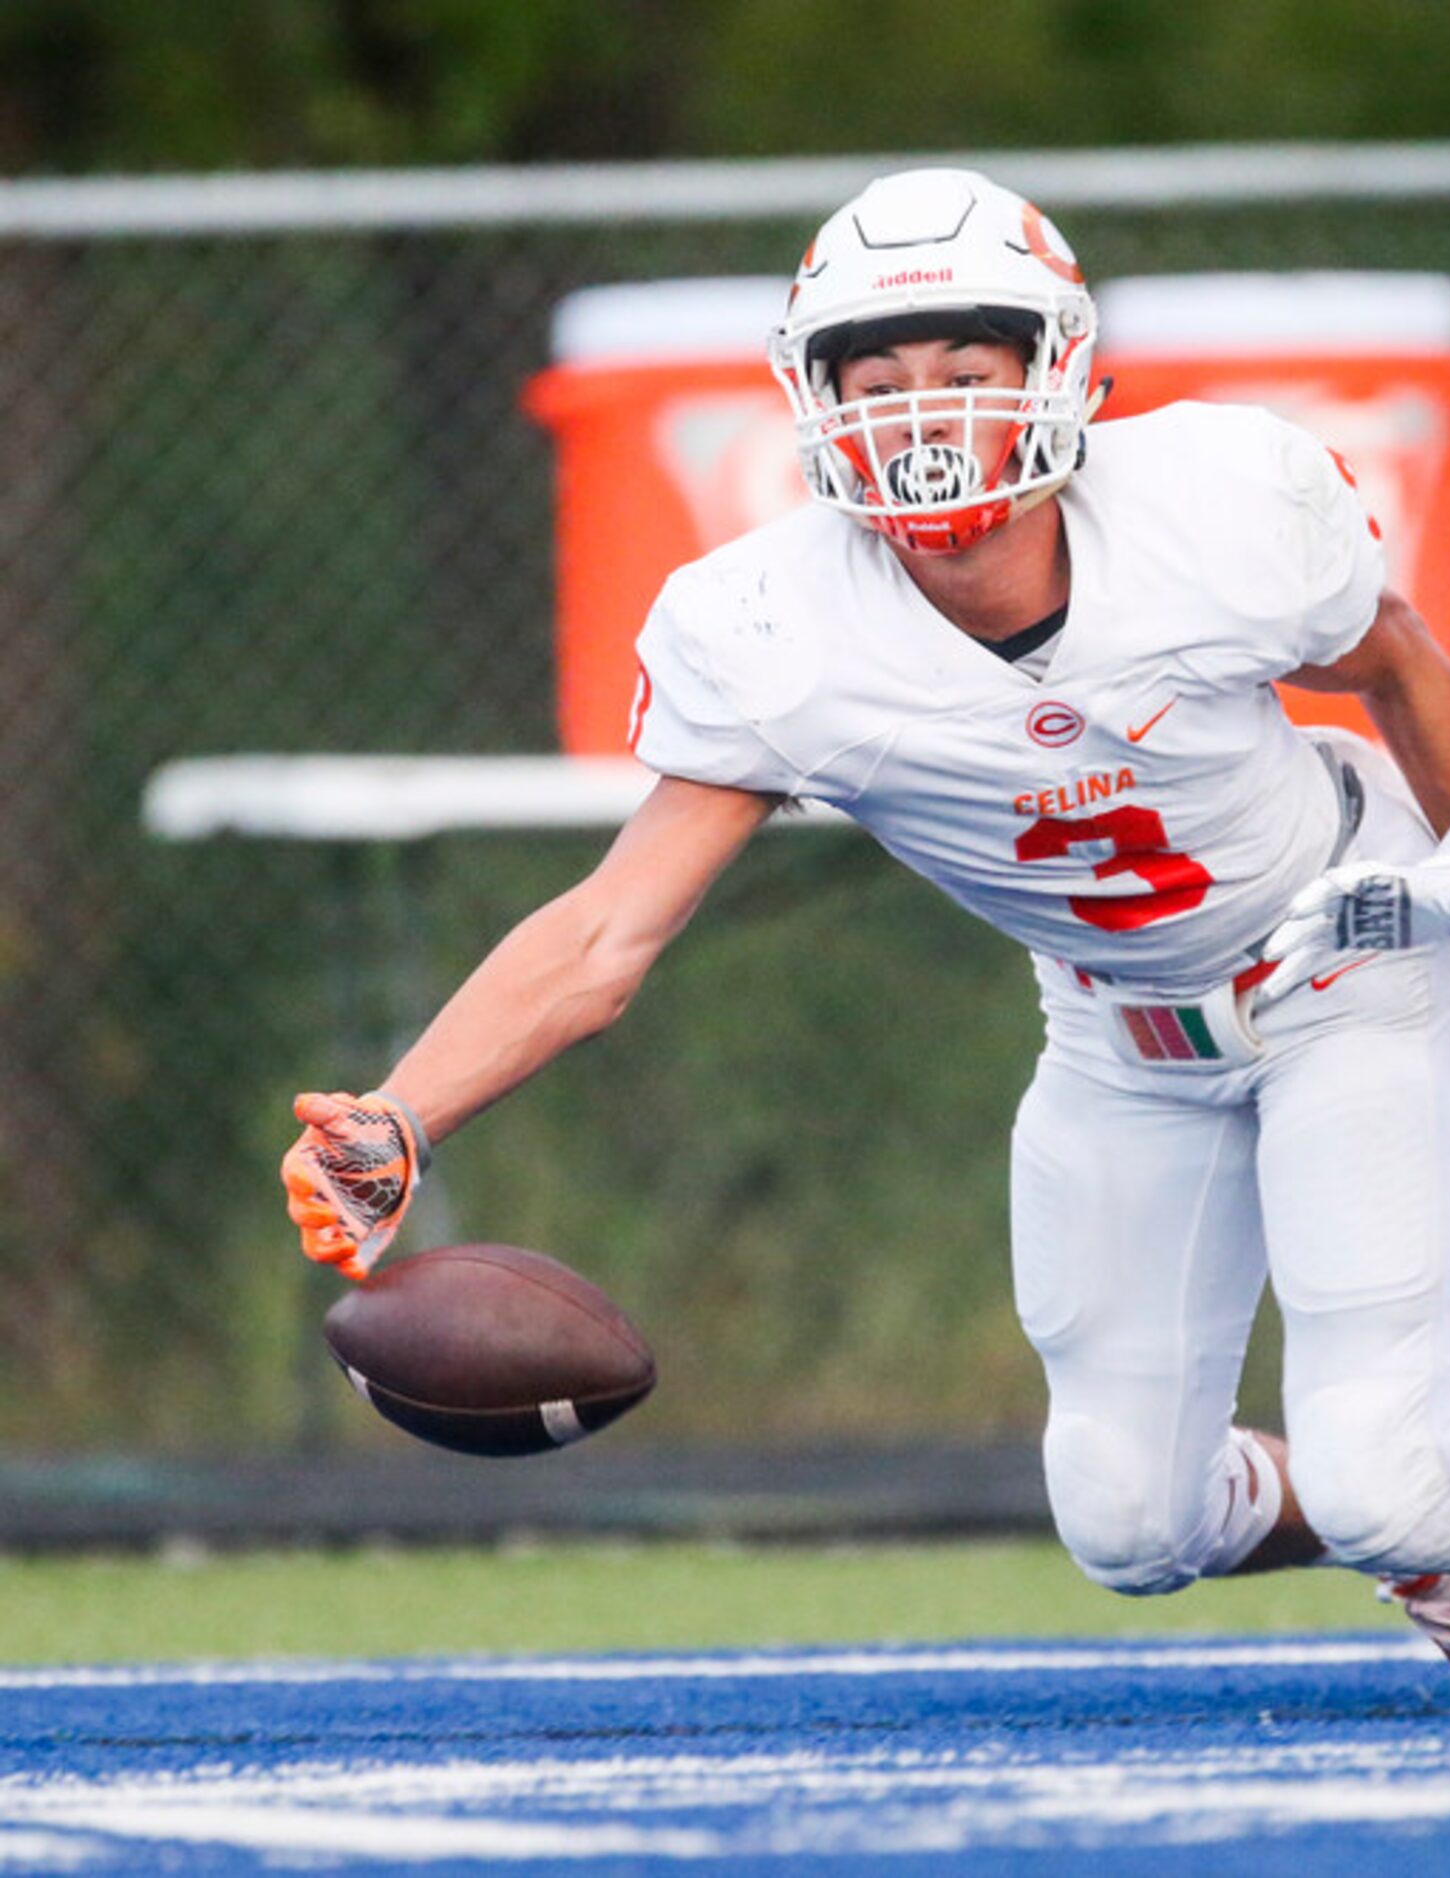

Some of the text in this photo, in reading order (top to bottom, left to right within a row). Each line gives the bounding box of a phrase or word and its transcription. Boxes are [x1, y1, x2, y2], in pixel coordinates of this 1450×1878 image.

[1033, 712, 1077, 736] C
[1013, 767, 1136, 816] CELINA
[1014, 804, 1214, 933] 3
